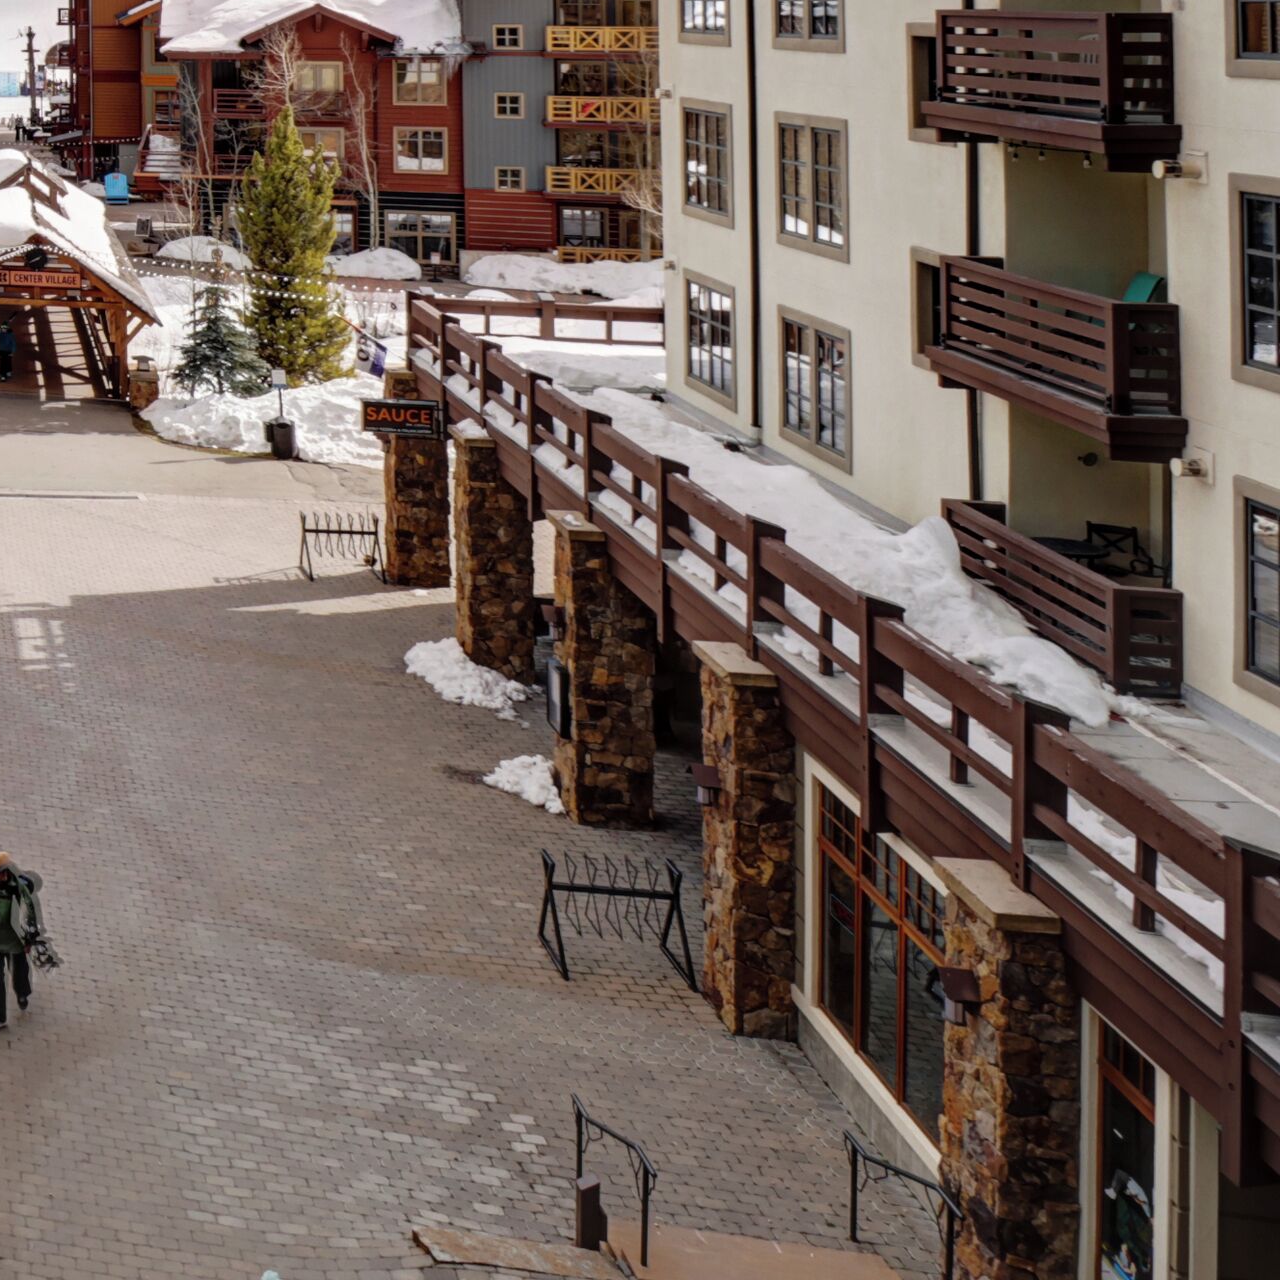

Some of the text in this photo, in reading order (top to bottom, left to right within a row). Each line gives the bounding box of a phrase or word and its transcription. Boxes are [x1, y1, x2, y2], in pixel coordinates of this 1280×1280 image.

[14, 273, 77, 285] CENTER VILLAGE
[366, 406, 431, 424] SAUCE
